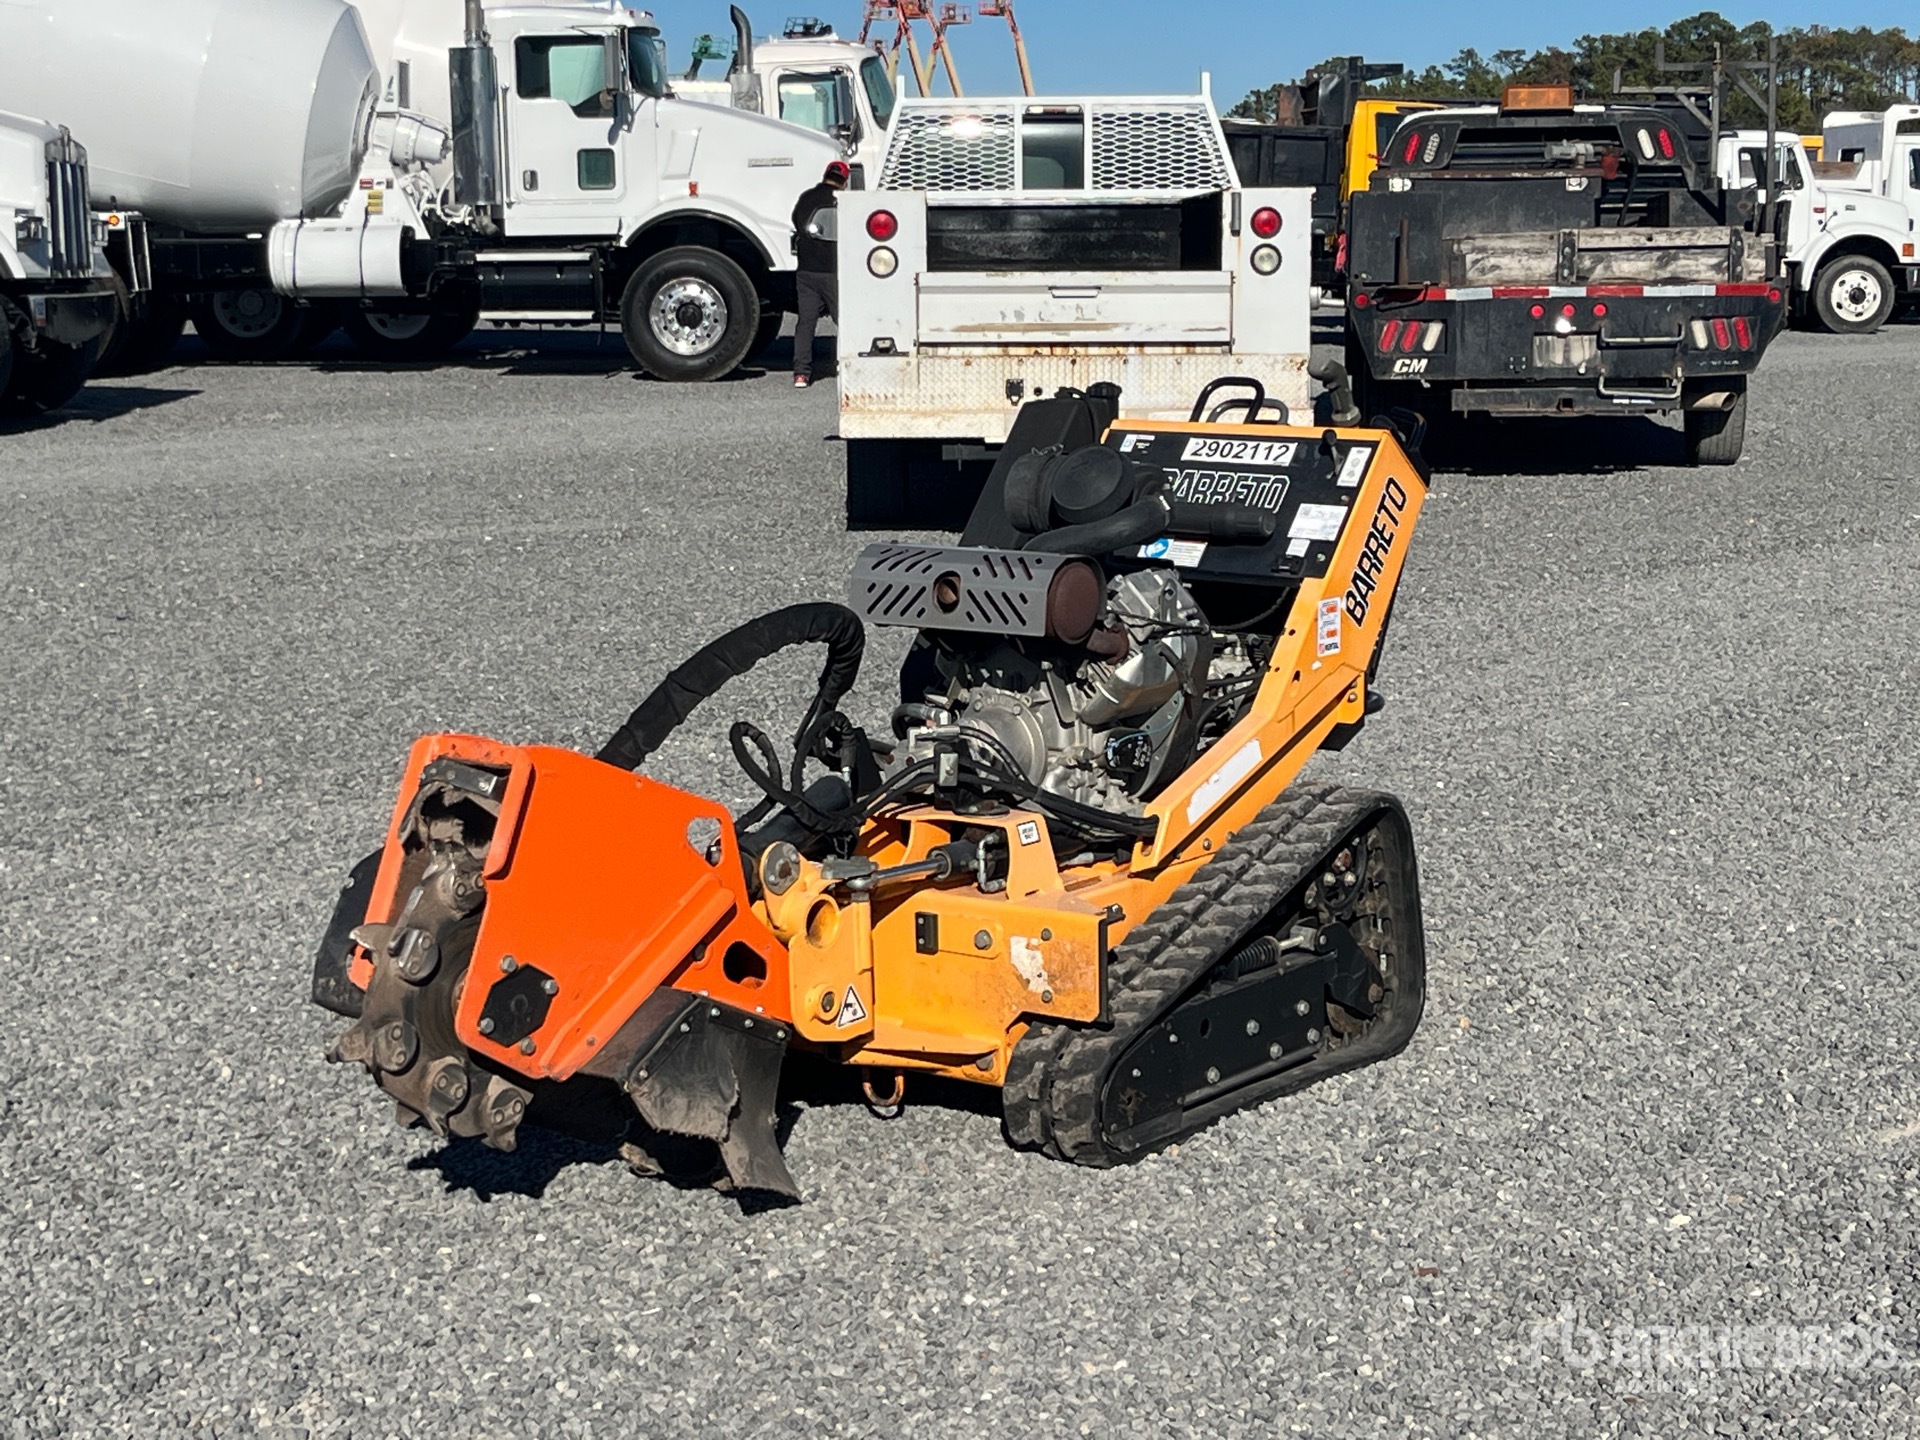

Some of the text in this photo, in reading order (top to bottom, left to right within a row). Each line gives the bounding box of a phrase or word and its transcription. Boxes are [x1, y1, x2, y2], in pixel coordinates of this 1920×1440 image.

[1392, 358, 1429, 373] CM
[1190, 440, 1290, 461] 2902112
[1344, 476, 1407, 628] BARRETO
